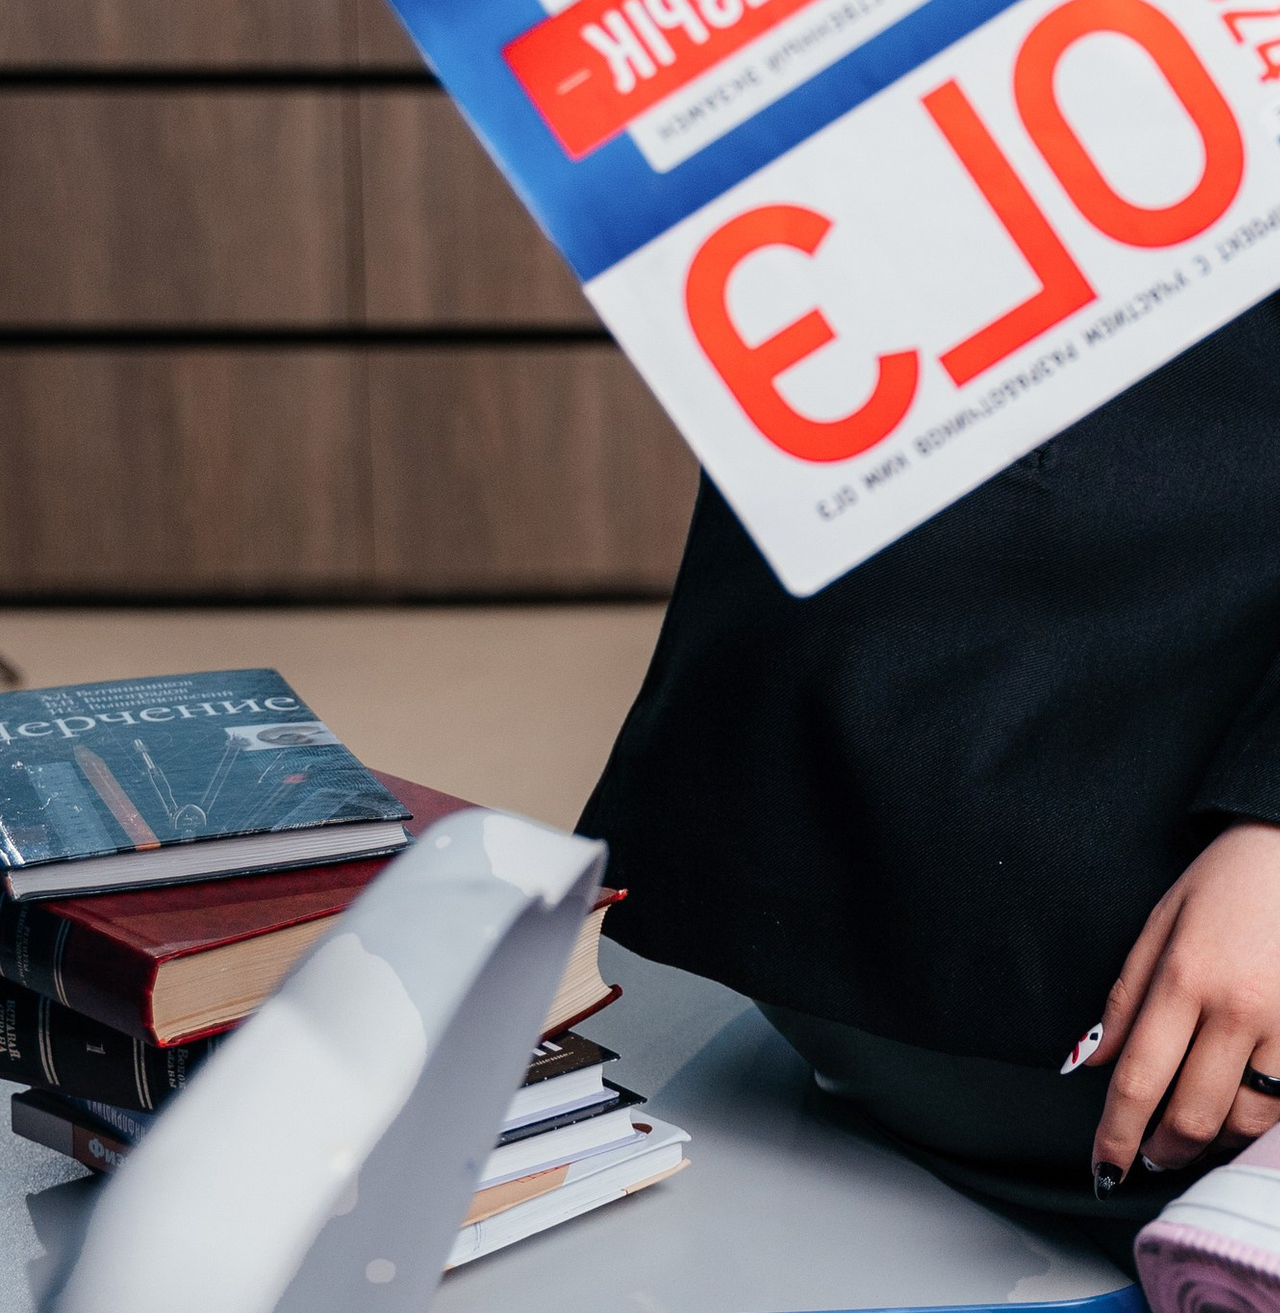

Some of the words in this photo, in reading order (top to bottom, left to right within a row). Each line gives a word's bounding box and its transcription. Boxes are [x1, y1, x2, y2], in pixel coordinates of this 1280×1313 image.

[653, 65, 762, 147] ЭКЗАМЕН
[1190, 252, 1212, 277] С
[1079, 267, 1189, 350] УЧАСТИЕМ
[910, 338, 1080, 461] РАЗРАБОТЧИКОВ
[858, 448, 911, 494] КИМ
[813, 482, 859, 523] ОГЭ
[88, 1137, 125, 1166] Физ
